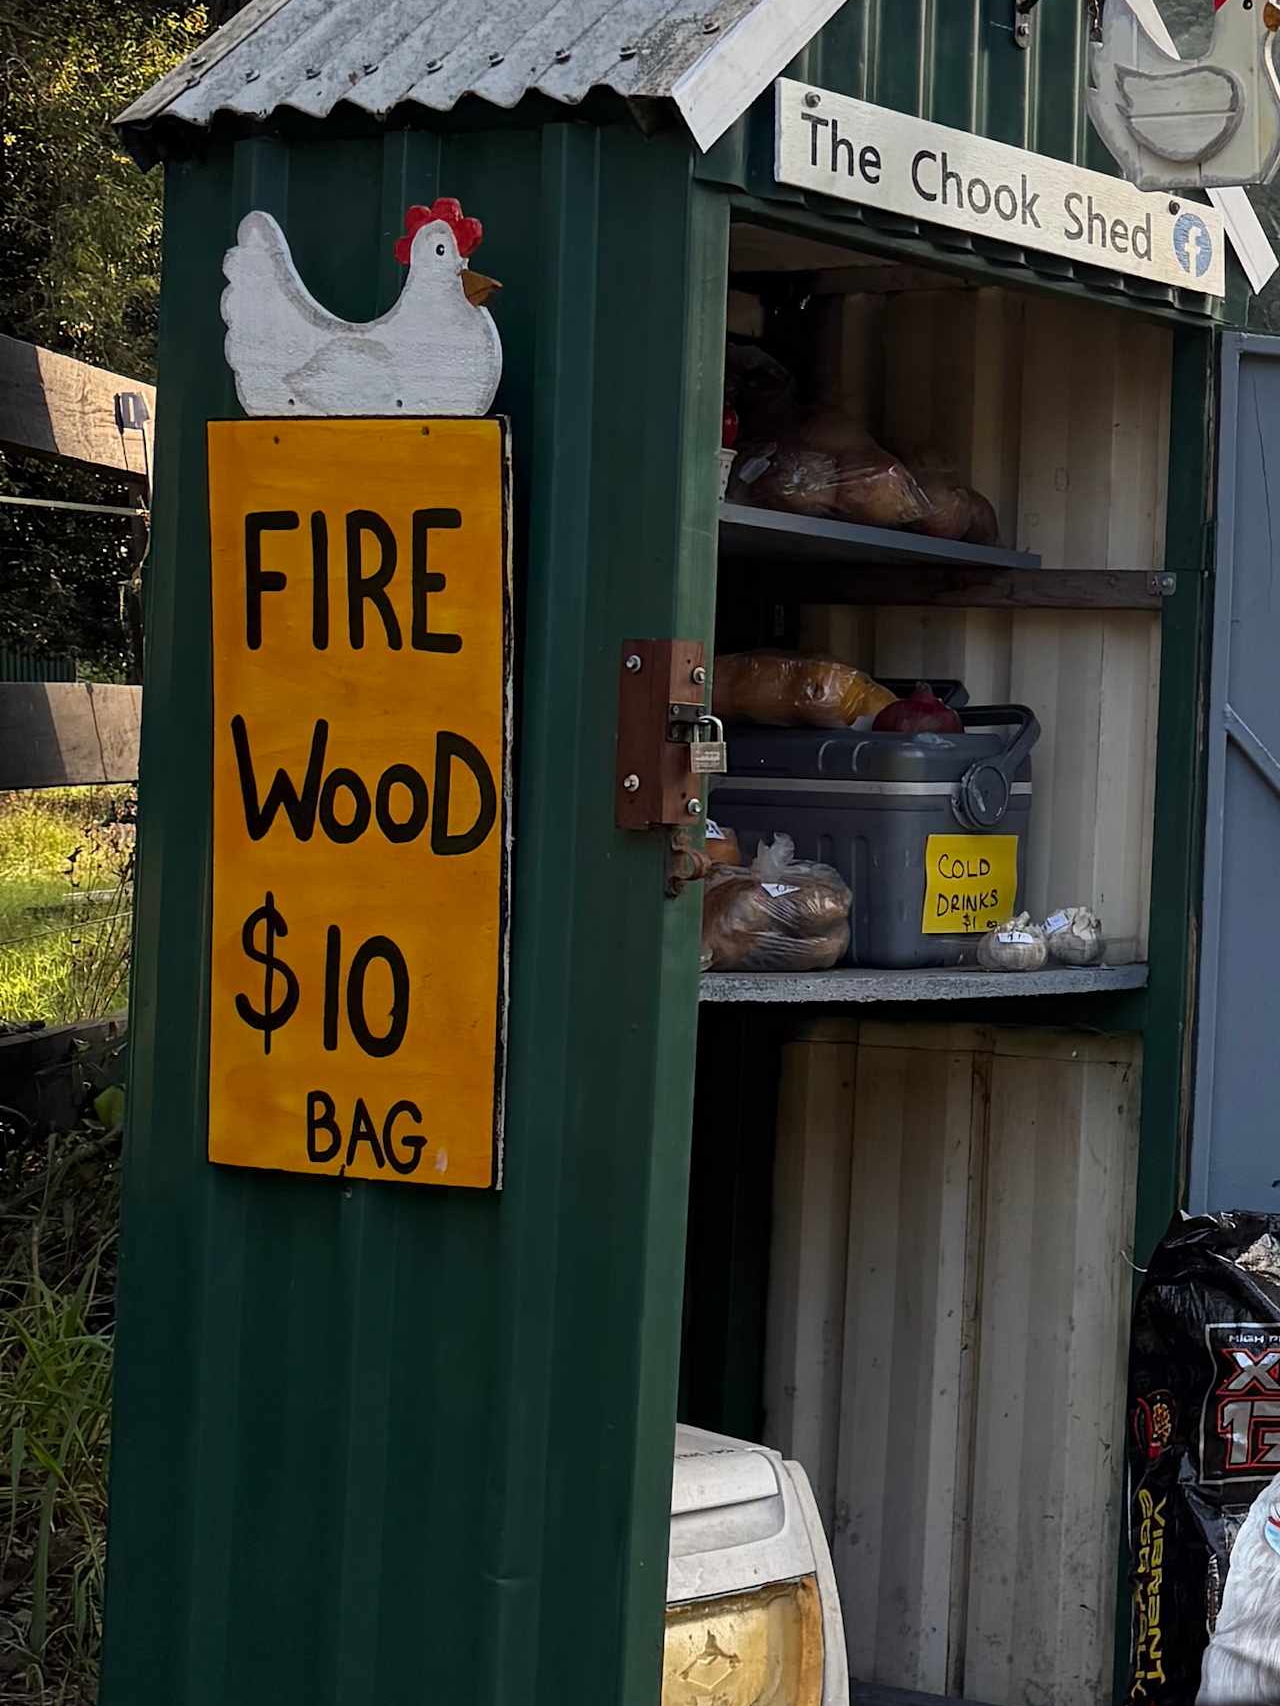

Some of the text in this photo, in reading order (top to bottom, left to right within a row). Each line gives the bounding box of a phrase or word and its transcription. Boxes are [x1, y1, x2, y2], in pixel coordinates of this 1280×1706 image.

[800, 112, 882, 185] The
[910, 149, 1041, 228] Chook
[1063, 192, 1152, 262] Shed
[245, 507, 463, 654] FIRE
[936, 889, 999, 917] DRINKS
[938, 853, 991, 879] COLD
[235, 890, 410, 1058] $10
[306, 1090, 427, 1175] BAG
[1228, 1333, 1265, 1344] HIGH
